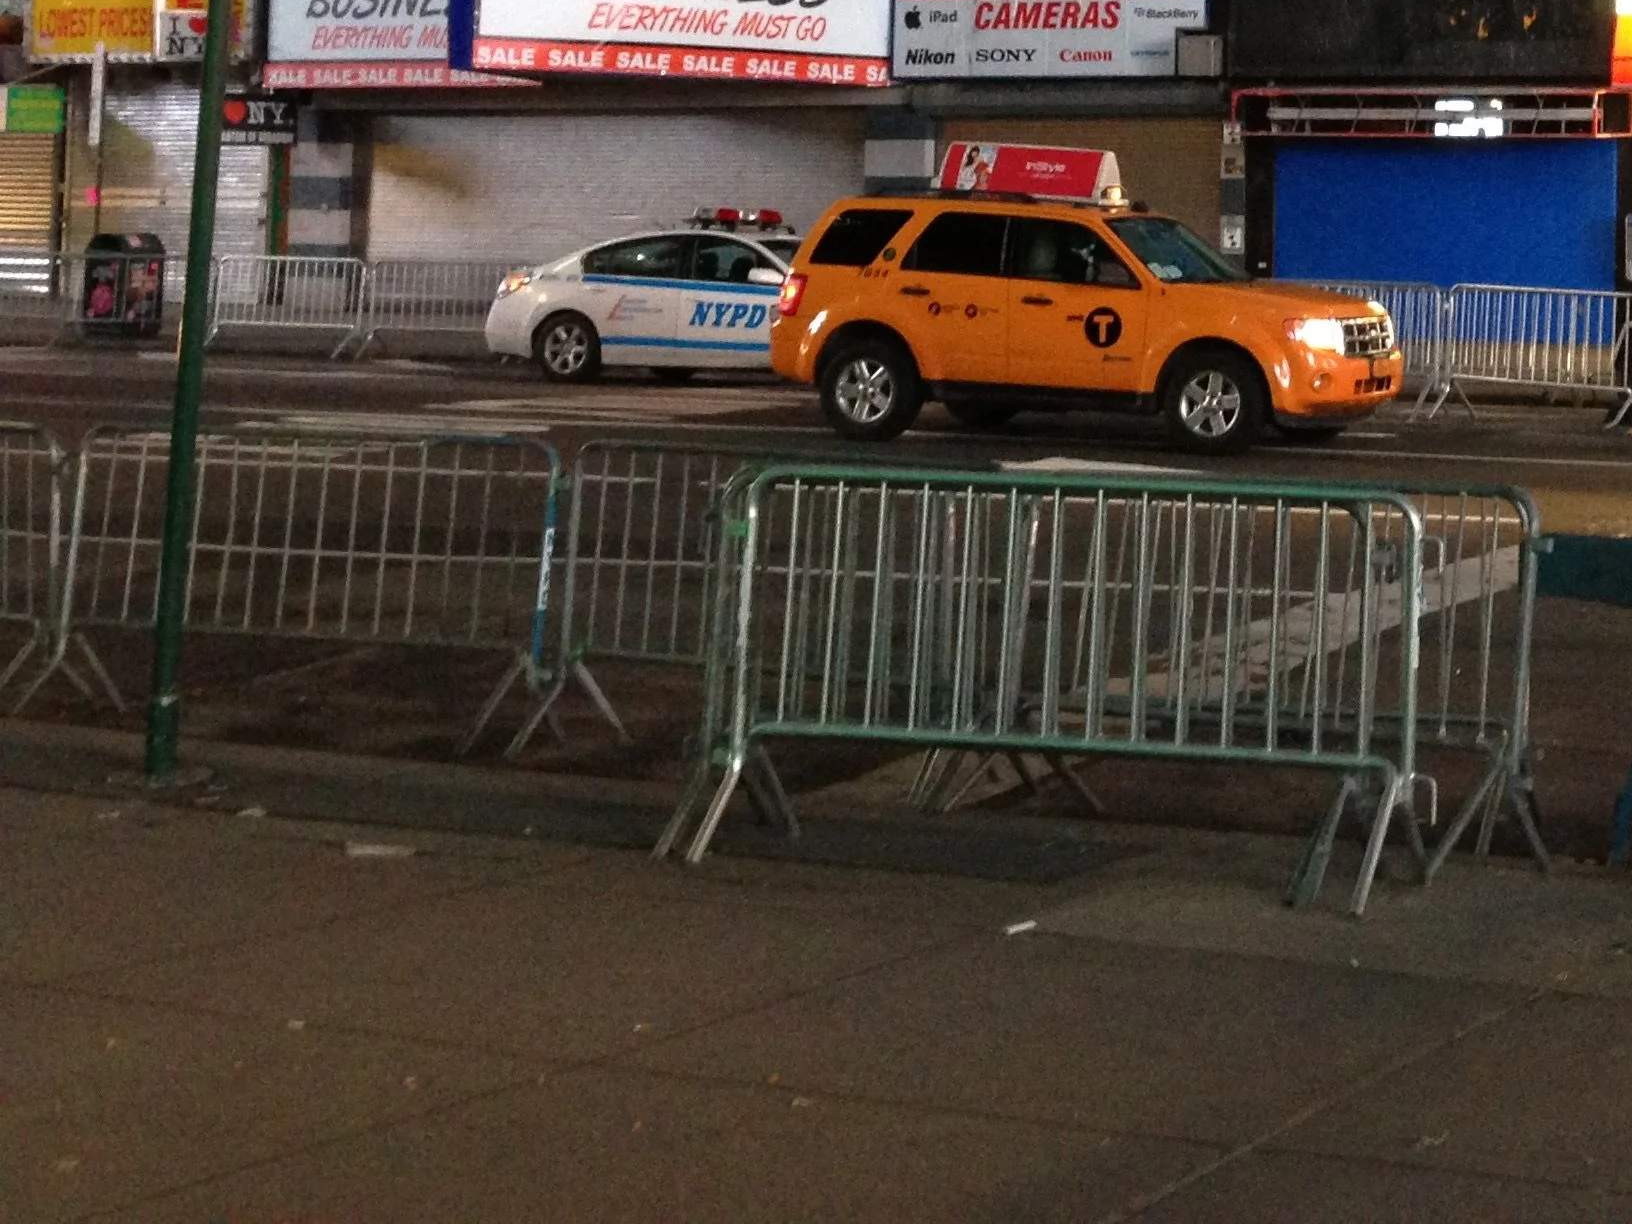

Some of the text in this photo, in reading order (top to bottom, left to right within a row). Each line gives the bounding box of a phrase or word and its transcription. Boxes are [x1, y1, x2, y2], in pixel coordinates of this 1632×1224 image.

[40, 8, 95, 38] LOWEST
[587, 2, 827, 42] EVERYTHING MUST GO
[928, 9, 958, 24] iPad
[974, 0, 1121, 30] CAMERAS
[1146, 8, 1199, 20] BlackBerry
[312, 26, 414, 50] EVERYTHING
[478, 45, 534, 66] SALE
[548, 48, 604, 69] SALE
[616, 52, 670, 73] SALE
[683, 55, 734, 76] SALE
[746, 59, 796, 79] SALE
[807, 63, 854, 82] SALE
[905, 48, 956, 66] Nikon
[976, 48, 1037, 62] SONY
[1060, 48, 1112, 62] Canon
[690, 302, 766, 328] NYPD
[1094, 316, 1114, 343] T
